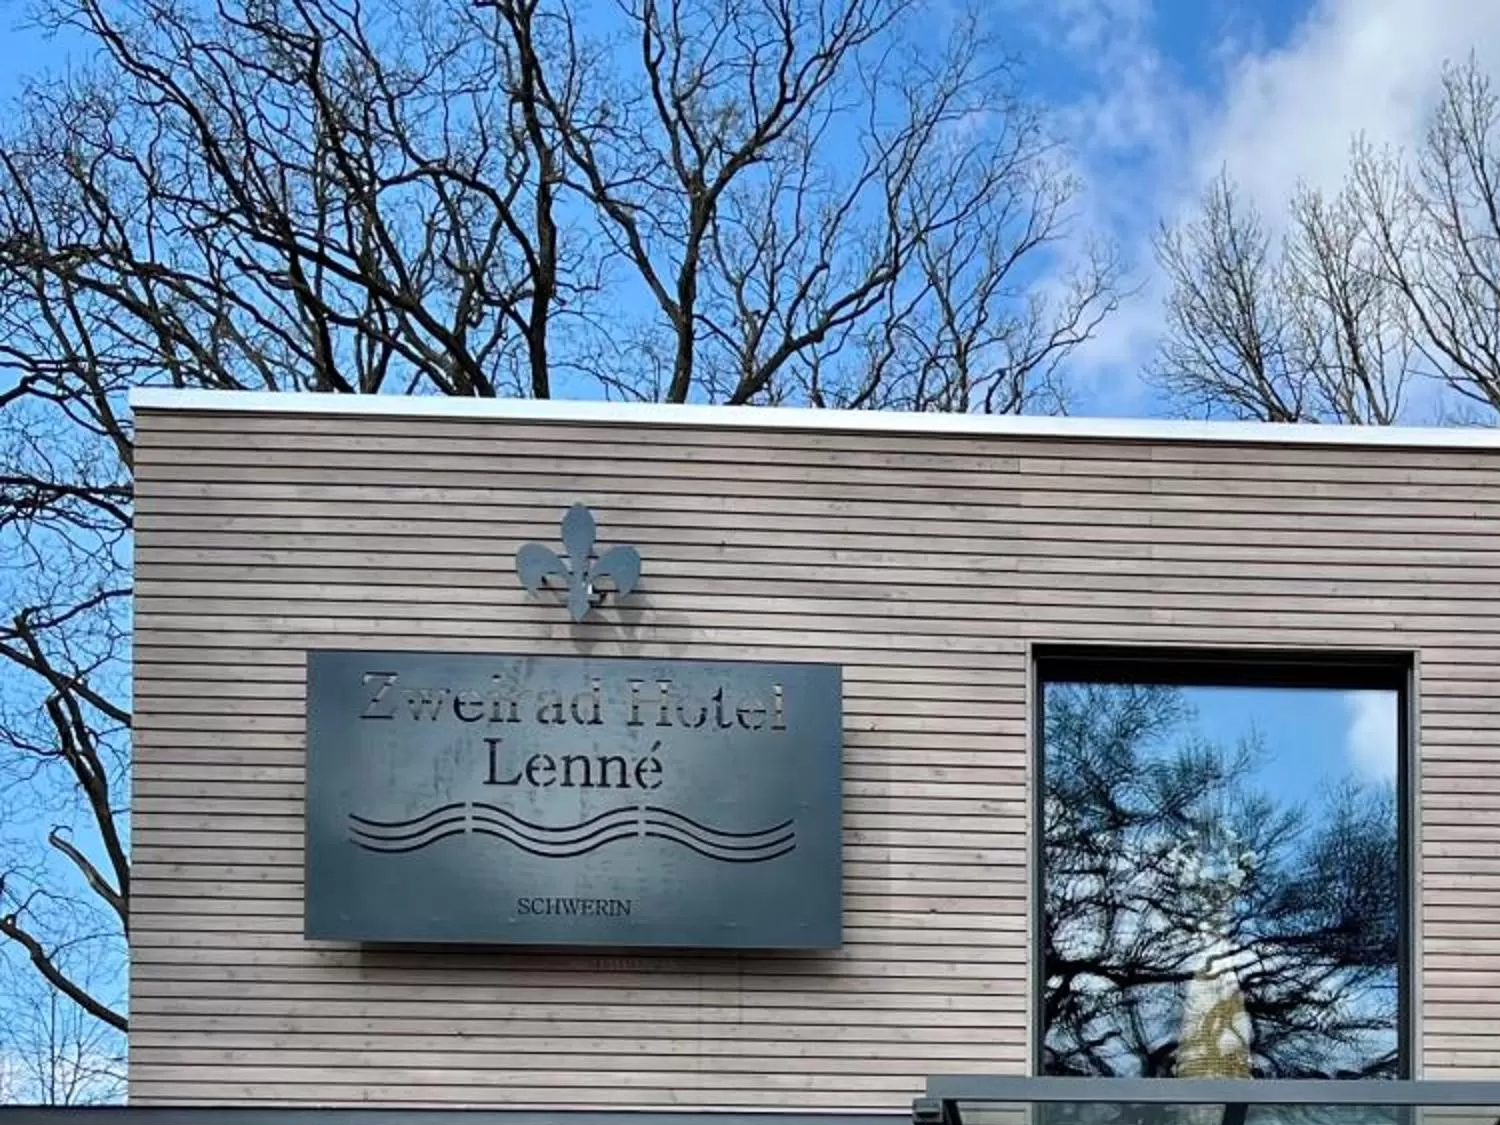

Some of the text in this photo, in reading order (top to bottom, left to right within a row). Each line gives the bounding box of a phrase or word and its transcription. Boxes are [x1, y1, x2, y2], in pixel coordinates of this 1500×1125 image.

[359, 672, 788, 732] Zweirad Hotel
[482, 737, 664, 790] Lenné
[517, 897, 632, 917] SCHWERIN
